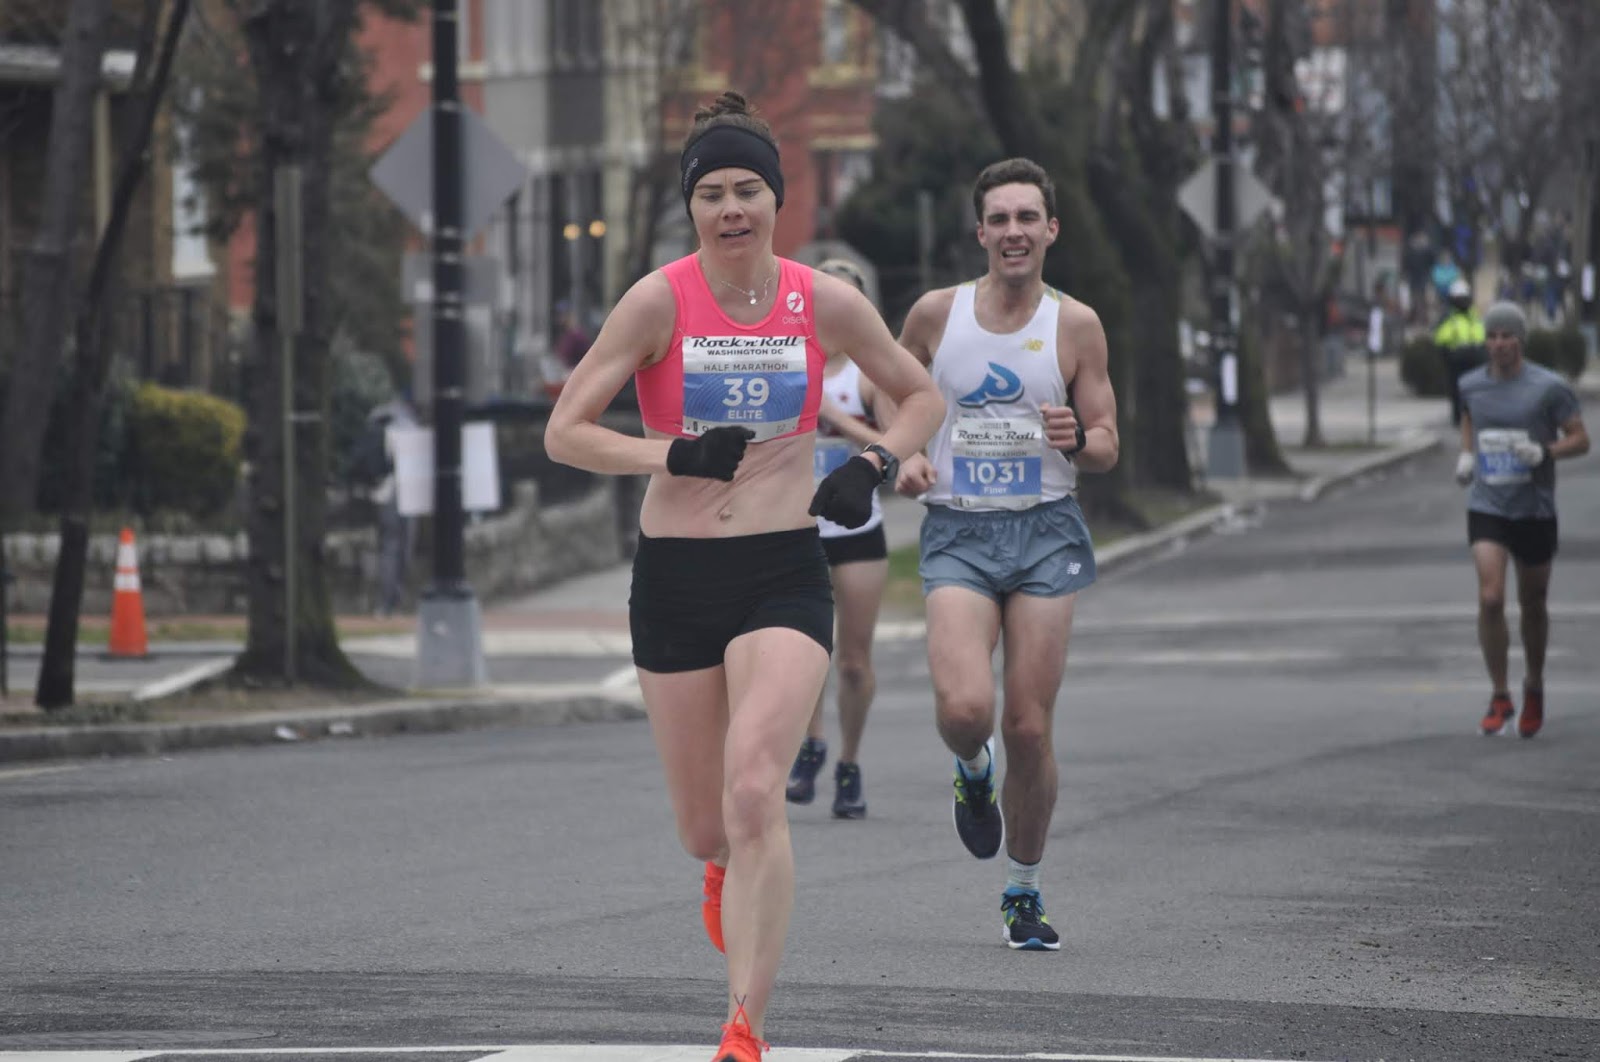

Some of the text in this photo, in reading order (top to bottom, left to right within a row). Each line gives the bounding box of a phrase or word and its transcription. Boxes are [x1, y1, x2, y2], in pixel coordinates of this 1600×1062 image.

[691, 336, 740, 348] Rock
[760, 336, 798, 347] Roll
[707, 348, 769, 356] WASHINGTON
[703, 362, 789, 372] HALF MARATHON
[722, 377, 770, 407] 39
[727, 409, 763, 420] ELITE
[957, 430, 991, 440] Rock
[1005, 430, 1036, 440] Roll
[965, 461, 1025, 484] 1031
[983, 486, 1007, 495] Finer
